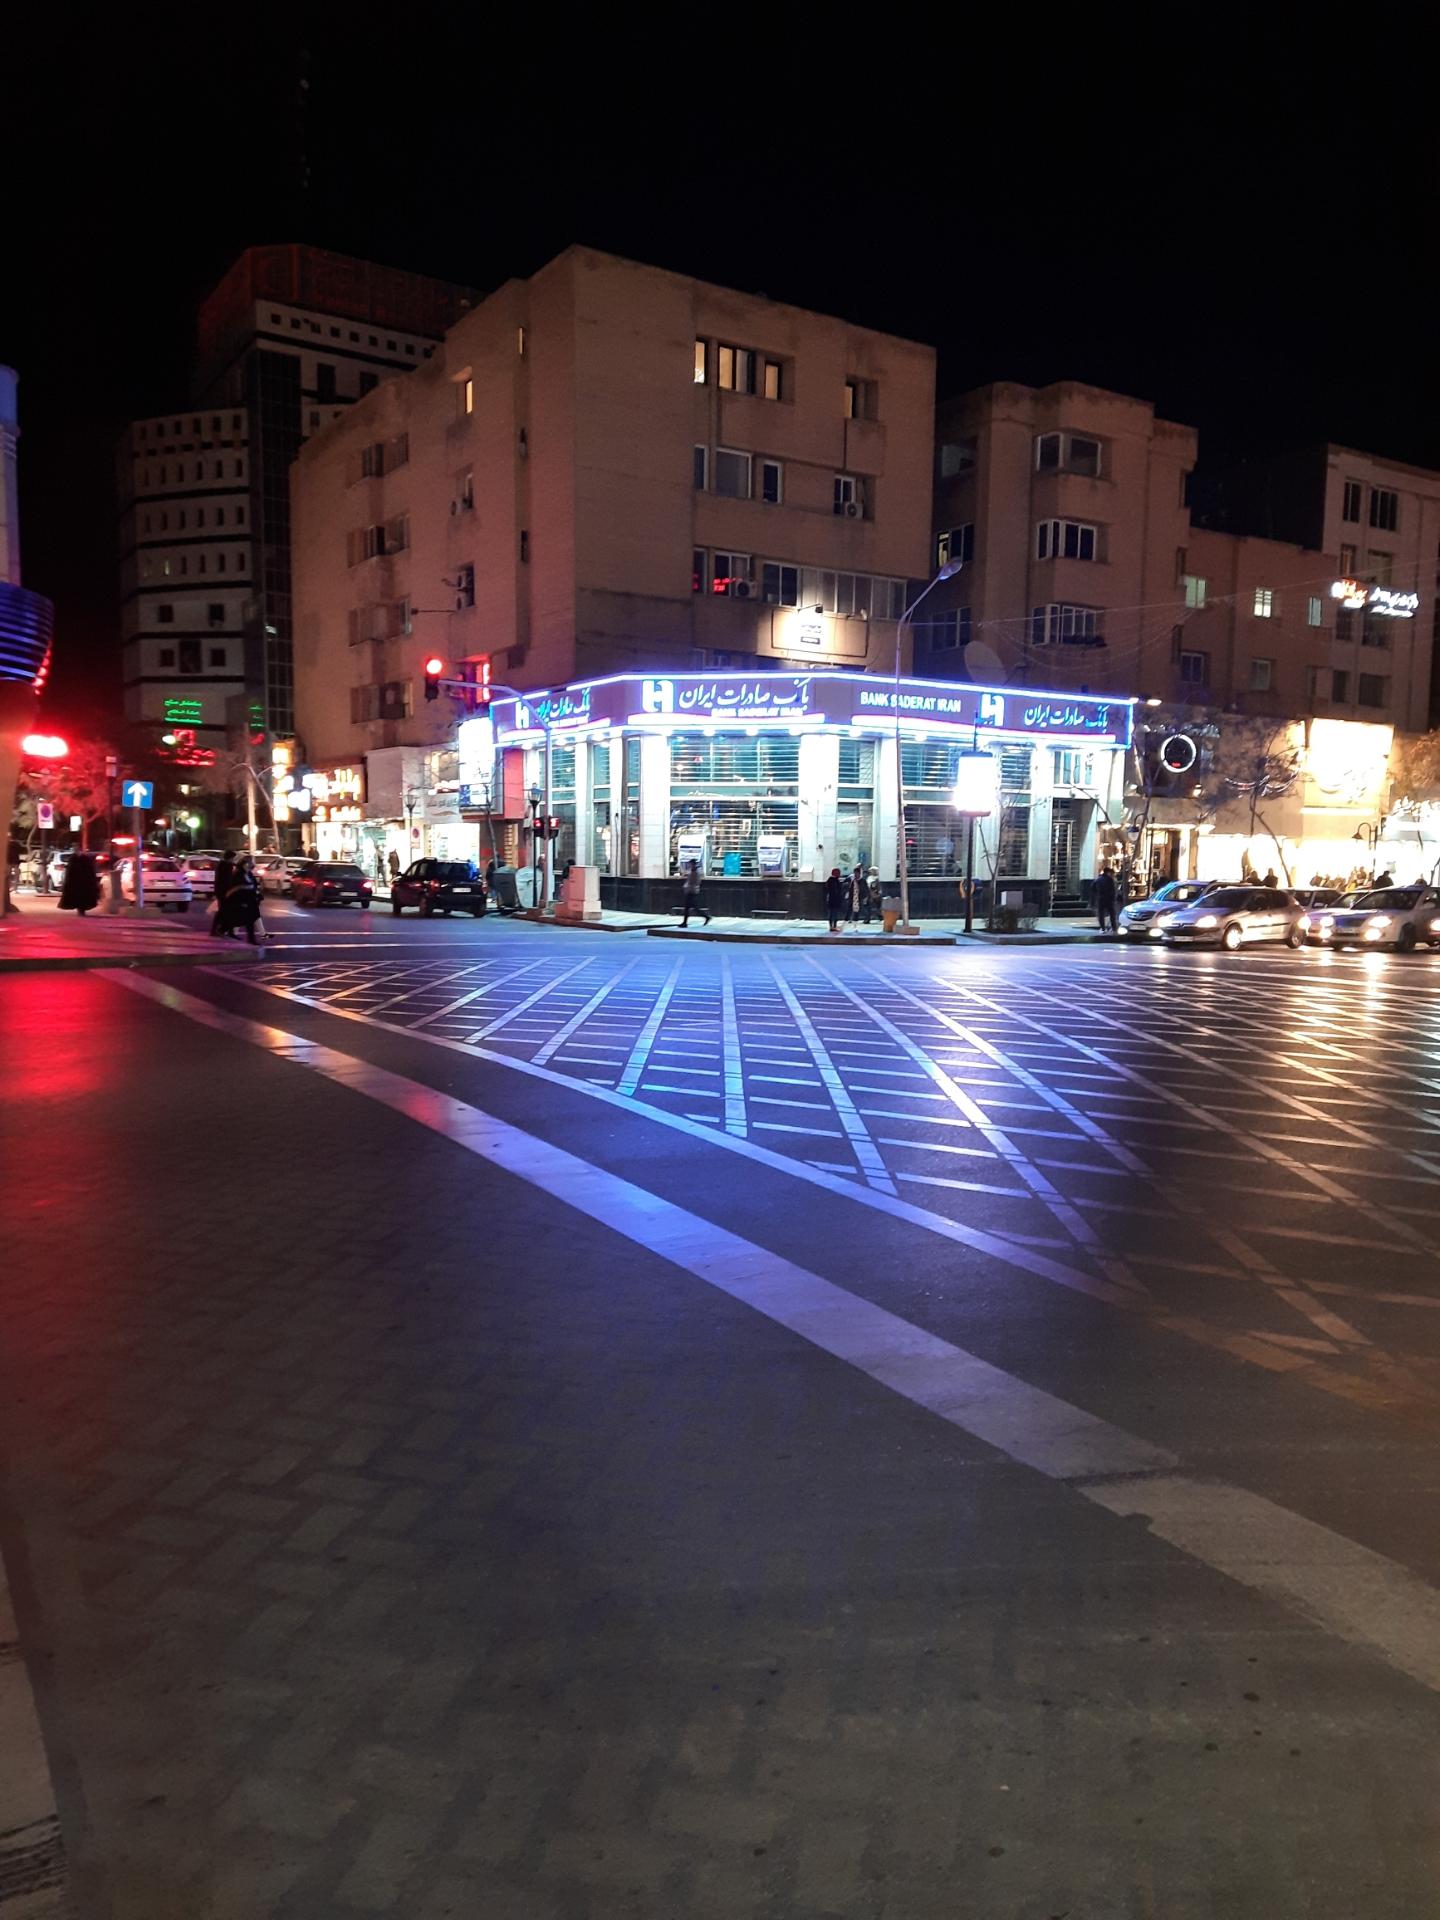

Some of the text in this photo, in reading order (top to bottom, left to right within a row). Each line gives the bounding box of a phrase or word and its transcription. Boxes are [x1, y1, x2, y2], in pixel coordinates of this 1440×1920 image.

[678, 676, 812, 711] بانک صادرات ایران
[860, 691, 962, 713] BANK SADERAT IRAN
[1024, 703, 1110, 733] بانک صادرات ایران
